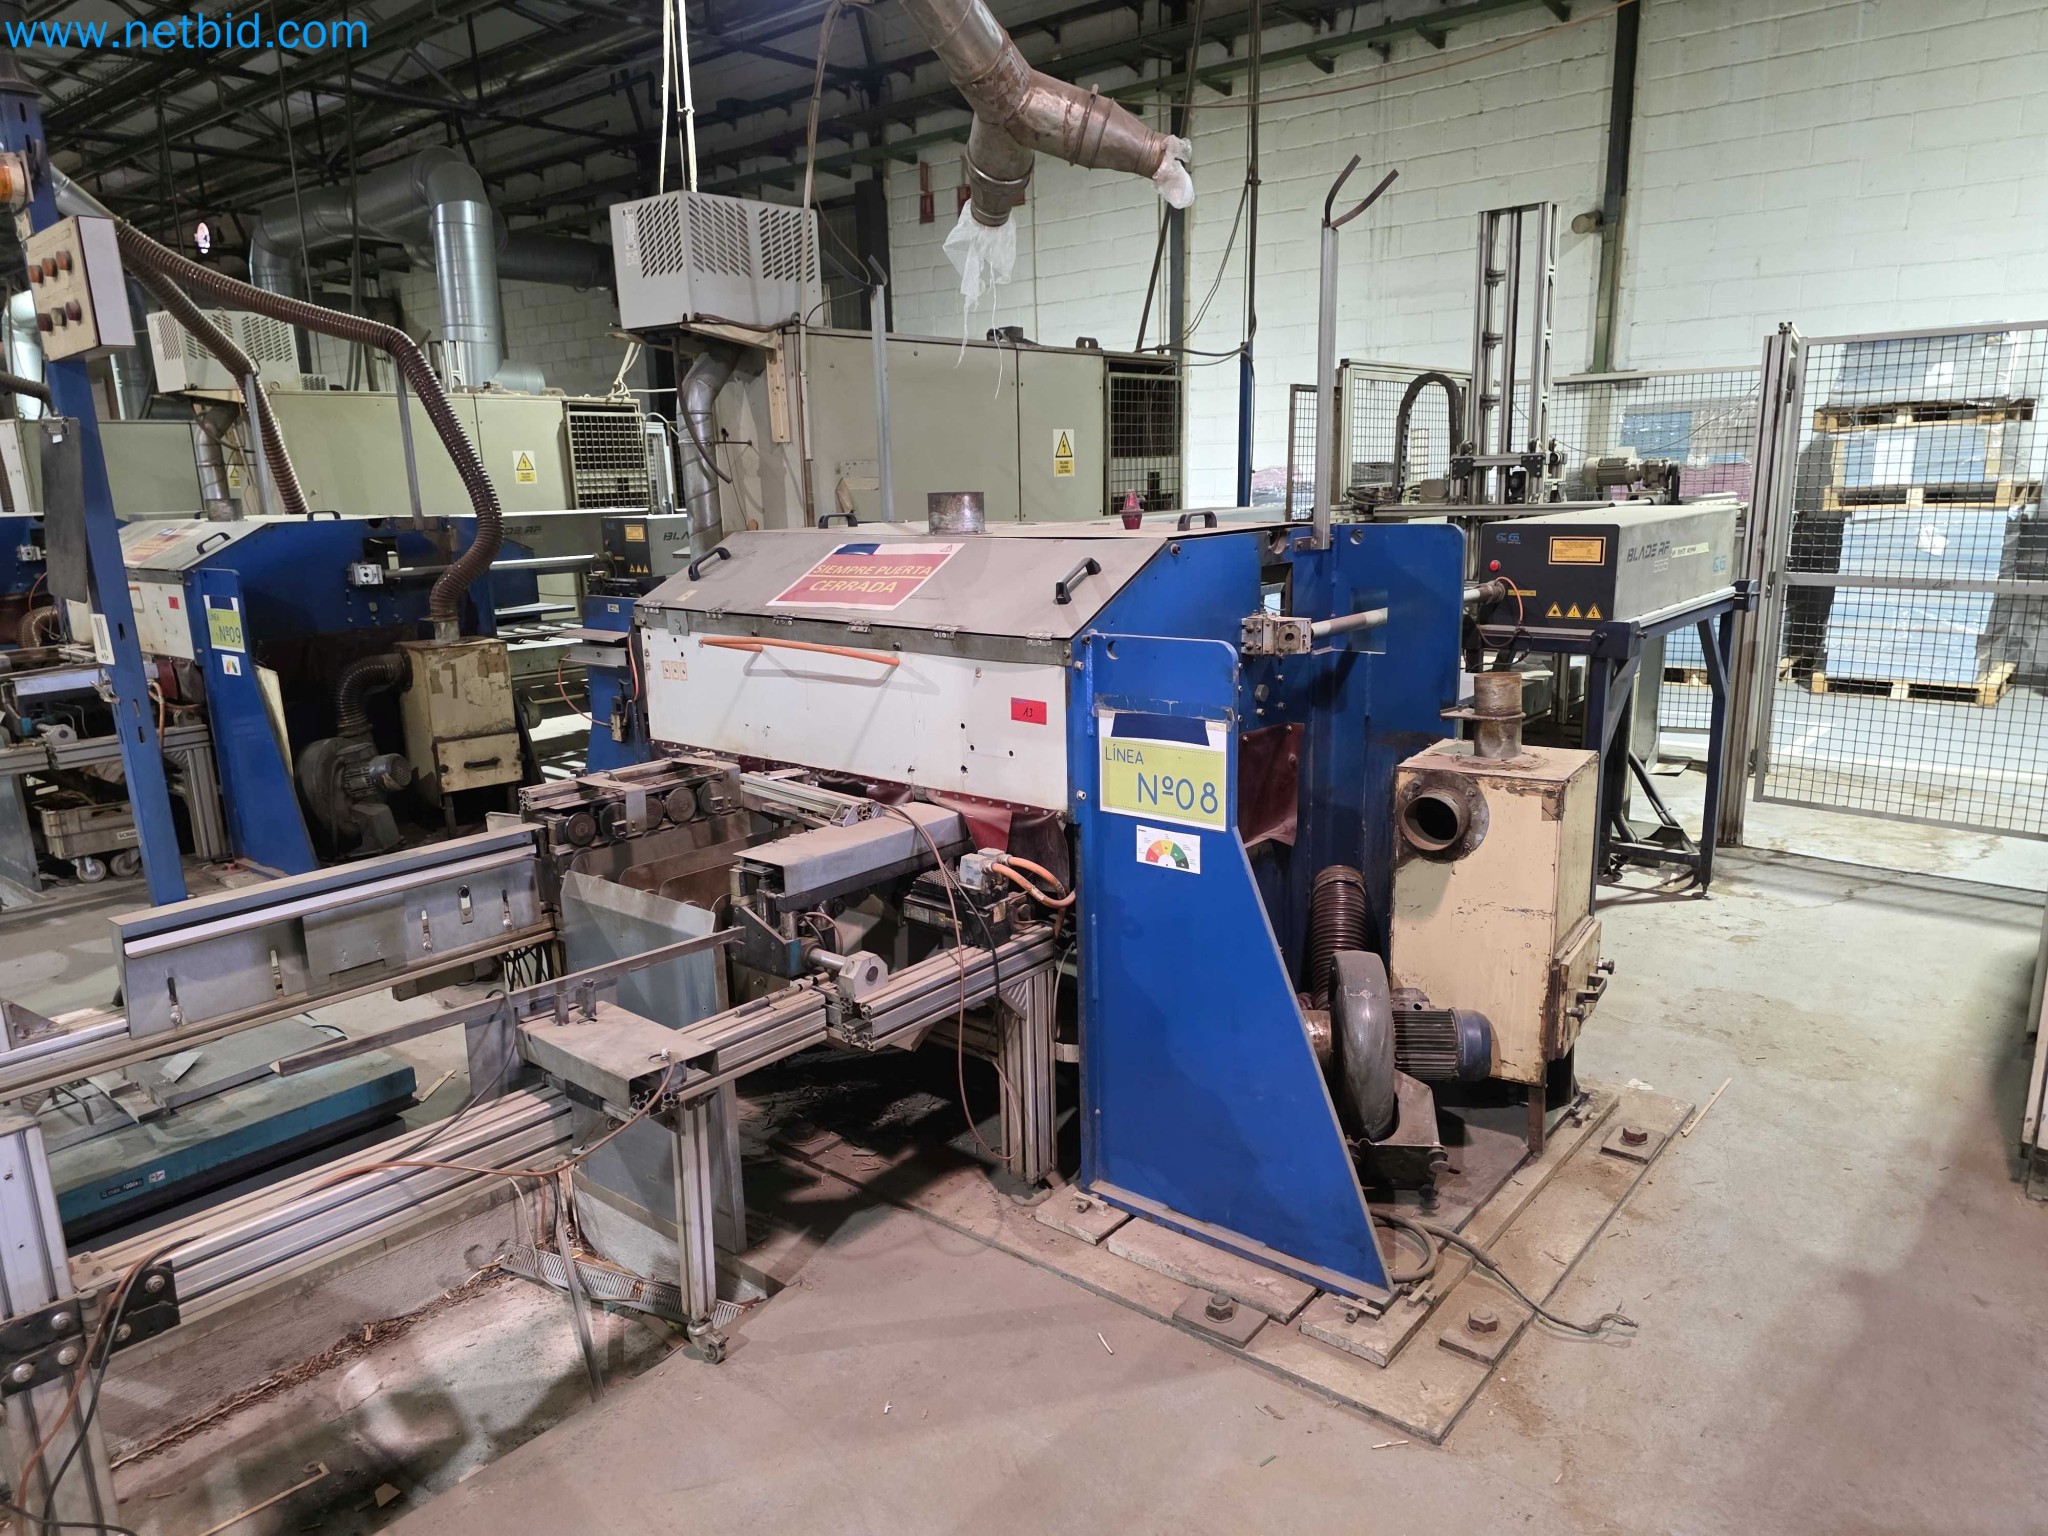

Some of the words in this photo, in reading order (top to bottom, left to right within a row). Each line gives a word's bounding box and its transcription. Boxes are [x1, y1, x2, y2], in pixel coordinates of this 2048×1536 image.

[1626, 543, 1658, 563] BLADE
[1658, 540, 1671, 556] RF
[813, 564, 876, 576] SIEMPRE
[874, 564, 933, 576] PUERTA
[809, 580, 898, 593] CERRADA
[1105, 743, 1144, 765] LÍNEA
